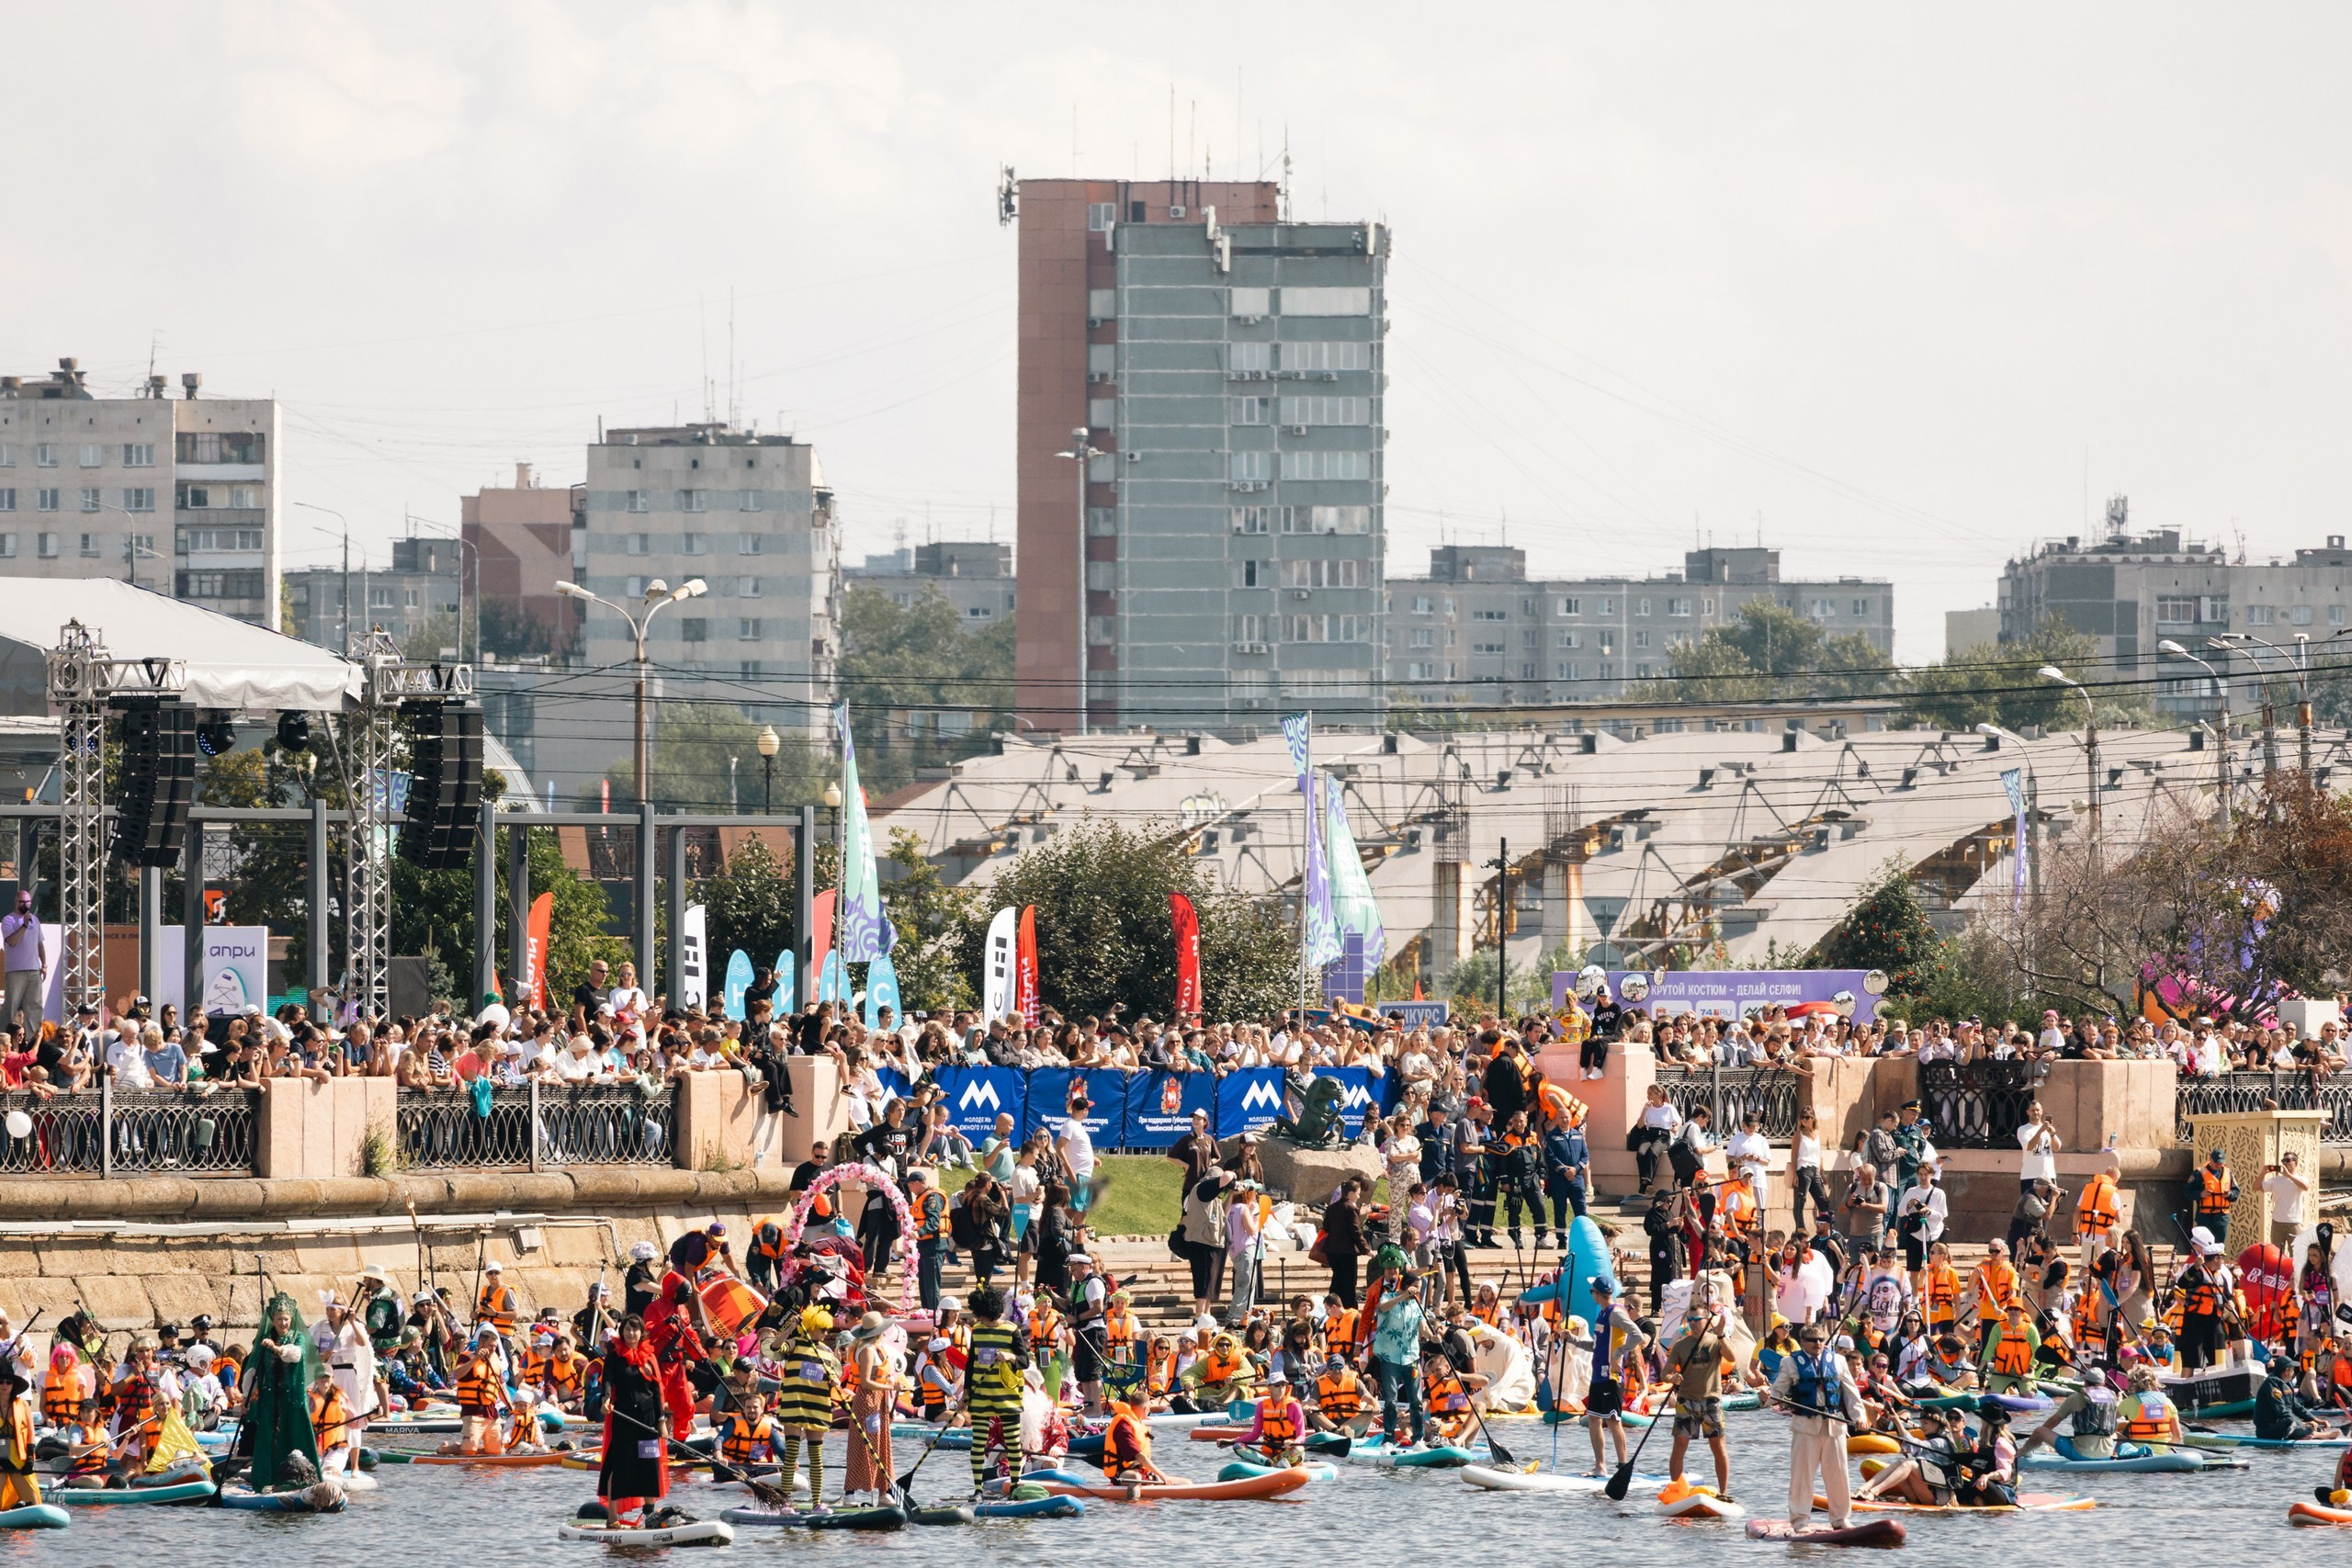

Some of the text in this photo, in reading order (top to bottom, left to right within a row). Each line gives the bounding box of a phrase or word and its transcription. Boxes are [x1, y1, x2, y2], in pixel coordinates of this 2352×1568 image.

[209, 945, 255, 959] апри
[1651, 983, 1685, 996] КРУТОЙ
[1689, 985, 1726, 996] КОСТЮМ
[1736, 983, 1767, 997] ДЕЛАЙ
[1769, 984, 1801, 996] СЕЛФИ!
[1385, 1008, 1441, 1024] КНКУРС
